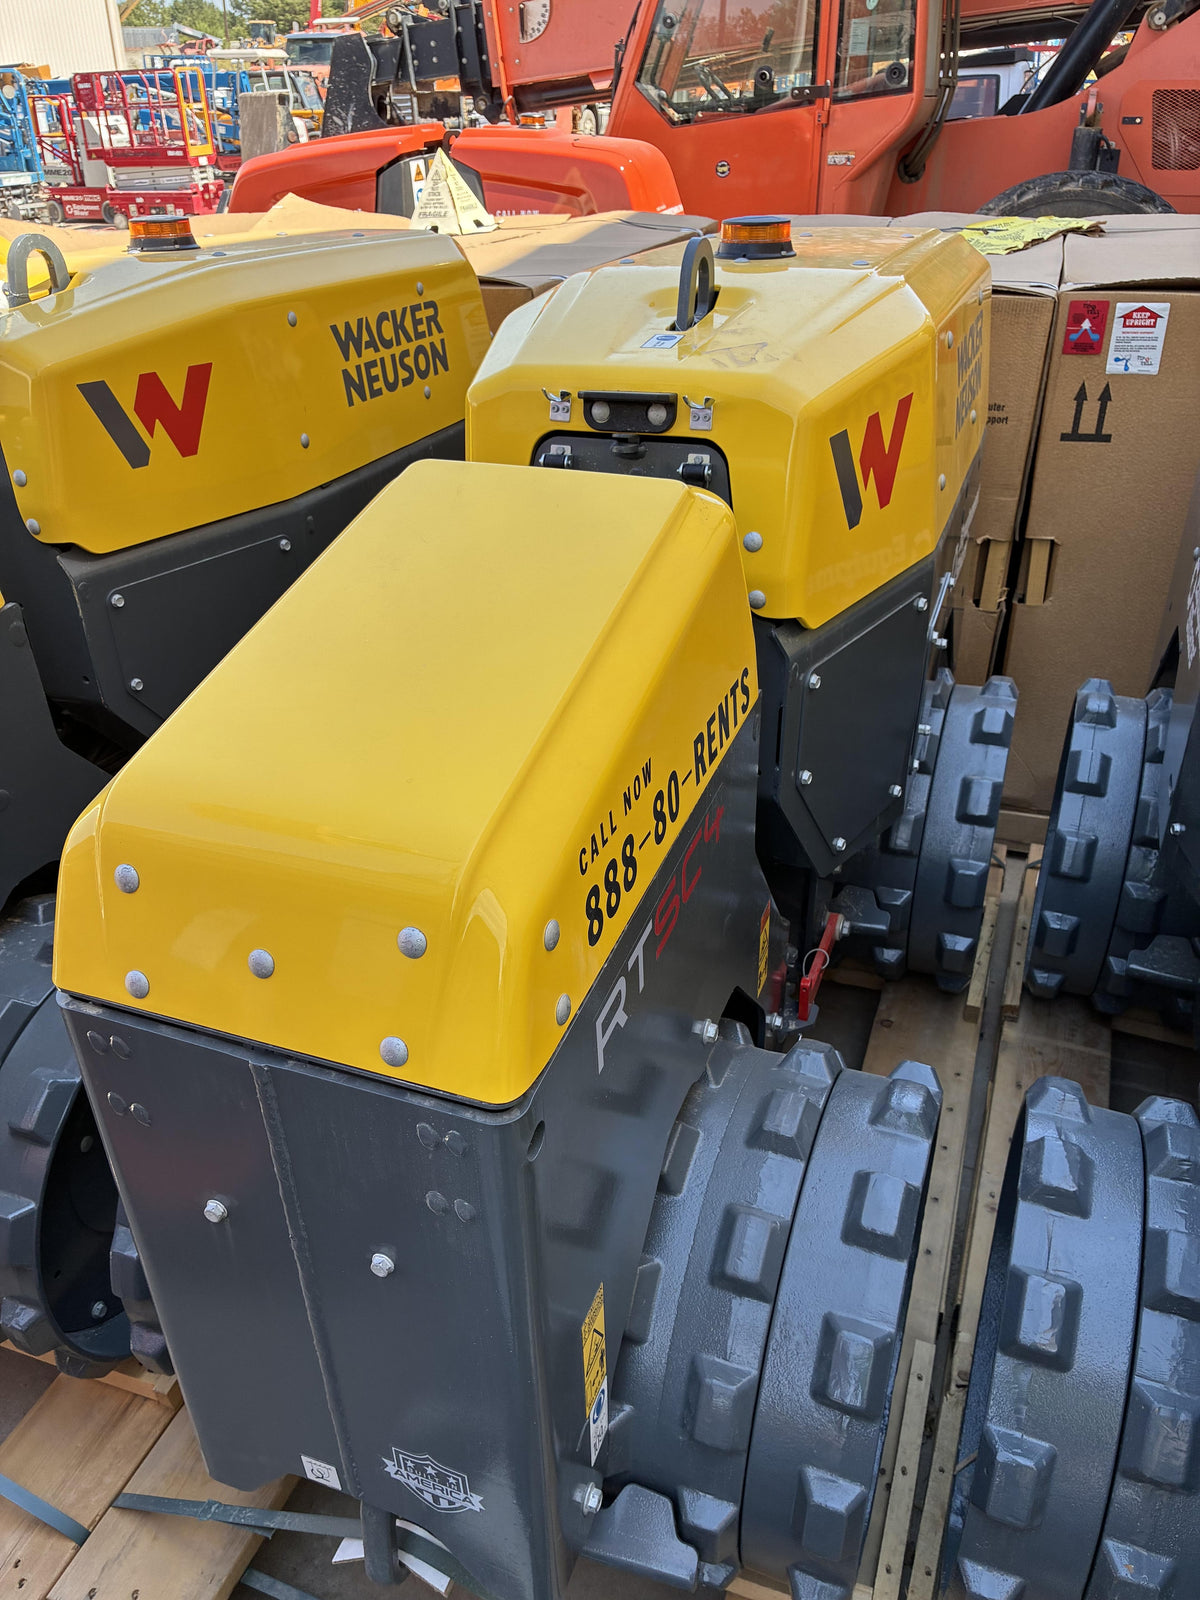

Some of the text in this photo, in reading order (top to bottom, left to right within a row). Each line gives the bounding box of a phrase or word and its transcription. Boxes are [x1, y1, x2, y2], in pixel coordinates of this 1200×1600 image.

[330, 299, 444, 363] WACKER
[957, 309, 984, 387] WACKER
[341, 338, 450, 407] NEUSON
[955, 353, 983, 440] NEUSON
[988, 402, 1006, 412] uter
[986, 416, 1009, 425] pport
[579, 757, 654, 876] CALL NOW
[585, 667, 753, 947] 888-80-RENTS
[393, 1468, 476, 1507] AMERICA
